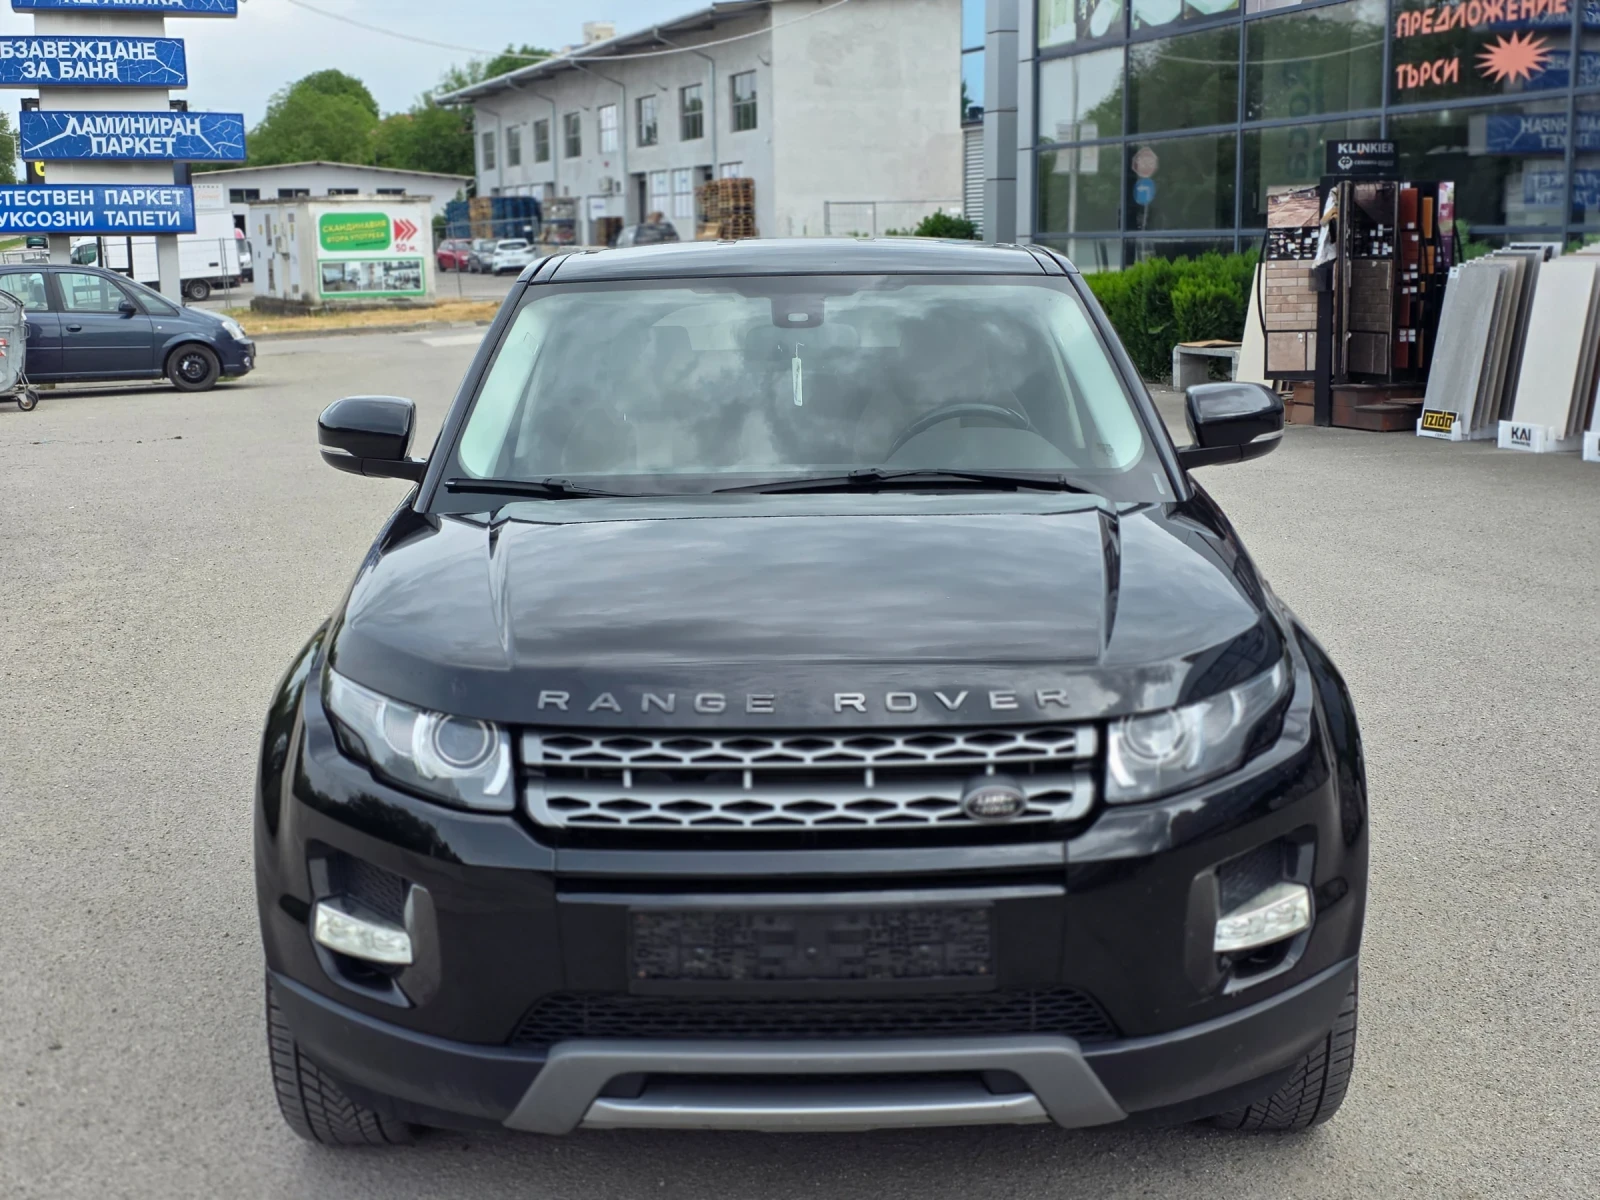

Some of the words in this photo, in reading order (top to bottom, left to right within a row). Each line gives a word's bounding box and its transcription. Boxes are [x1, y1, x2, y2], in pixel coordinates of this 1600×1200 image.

[1396, 0, 1567, 38] ПРЕДЛОЖЕНИЕ
[0, 41, 157, 60] БЗАВЕЖДАНЕ
[23, 61, 52, 78] ЗА
[60, 61, 118, 79] БАНЯ
[1395, 57, 1459, 89] ТЪРСИ
[65, 117, 200, 135] ЛАМИНИРАН
[91, 137, 176, 154] ПАРКЕТ
[1338, 142, 1394, 154] KLINKIER
[0, 189, 94, 206] ТЕСТВЕН
[105, 189, 184, 206] ПАРКЕТ
[104, 210, 181, 226] ТАПЕТИ
[395, 243, 407, 252] 50
[1511, 426, 1531, 441] KAI
[537, 690, 775, 714] RANGE
[833, 687, 1069, 713] ROVER
